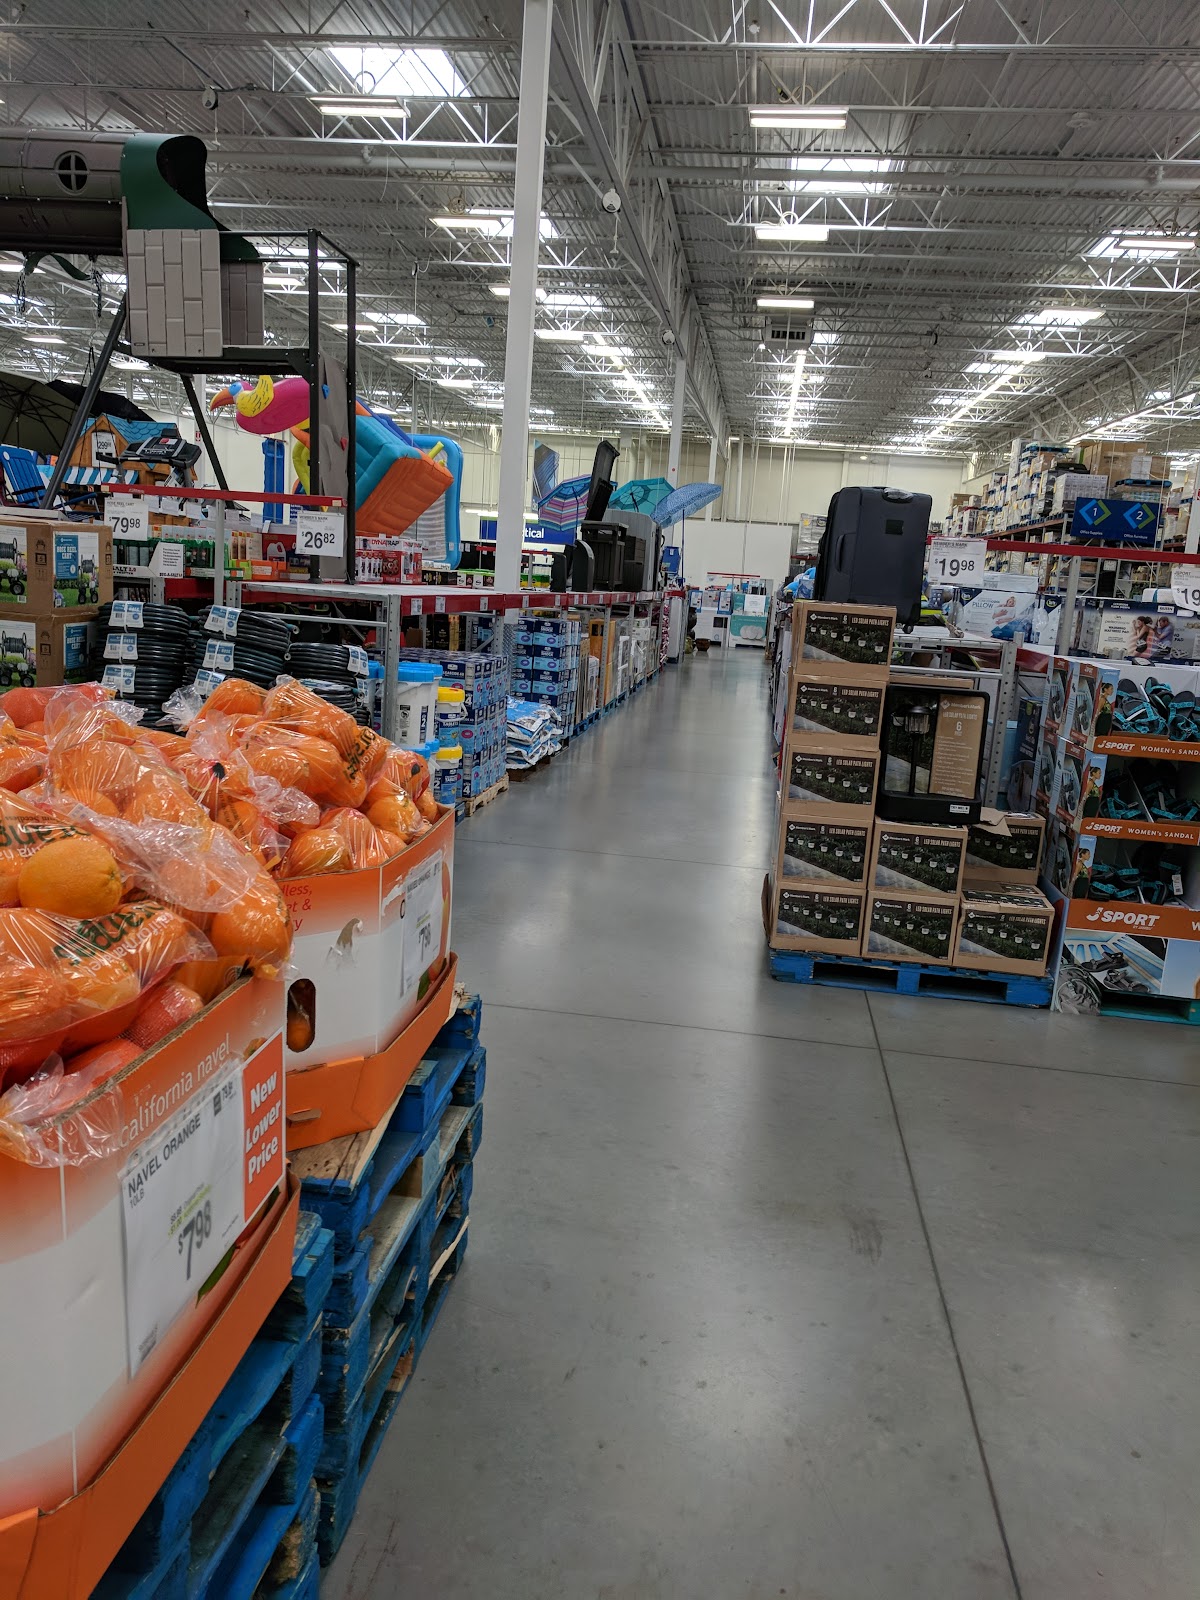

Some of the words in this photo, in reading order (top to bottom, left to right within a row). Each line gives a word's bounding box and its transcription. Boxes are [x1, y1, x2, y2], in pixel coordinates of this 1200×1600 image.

[1092, 508, 1098, 516] 1
[1136, 510, 1144, 520] 2
[523, 528, 544, 539] tical
[956, 721, 962, 731] 6
[1097, 740, 1135, 751] JSPORT
[1178, 748, 1200, 756] SAND
[463, 786, 470, 794] 4
[1085, 822, 1123, 833] JSPORT
[1164, 831, 1194, 840] SANDAL
[302, 898, 311, 910] &
[1086, 907, 1160, 927] JSPORT
[118, 1072, 193, 1148] california
[197, 1032, 230, 1081] navel
[250, 1071, 277, 1114] New
[245, 1100, 281, 1154] Lower
[128, 1156, 162, 1198] NAVEL
[163, 1113, 200, 1161] ORANGE
[248, 1136, 278, 1184] Price
